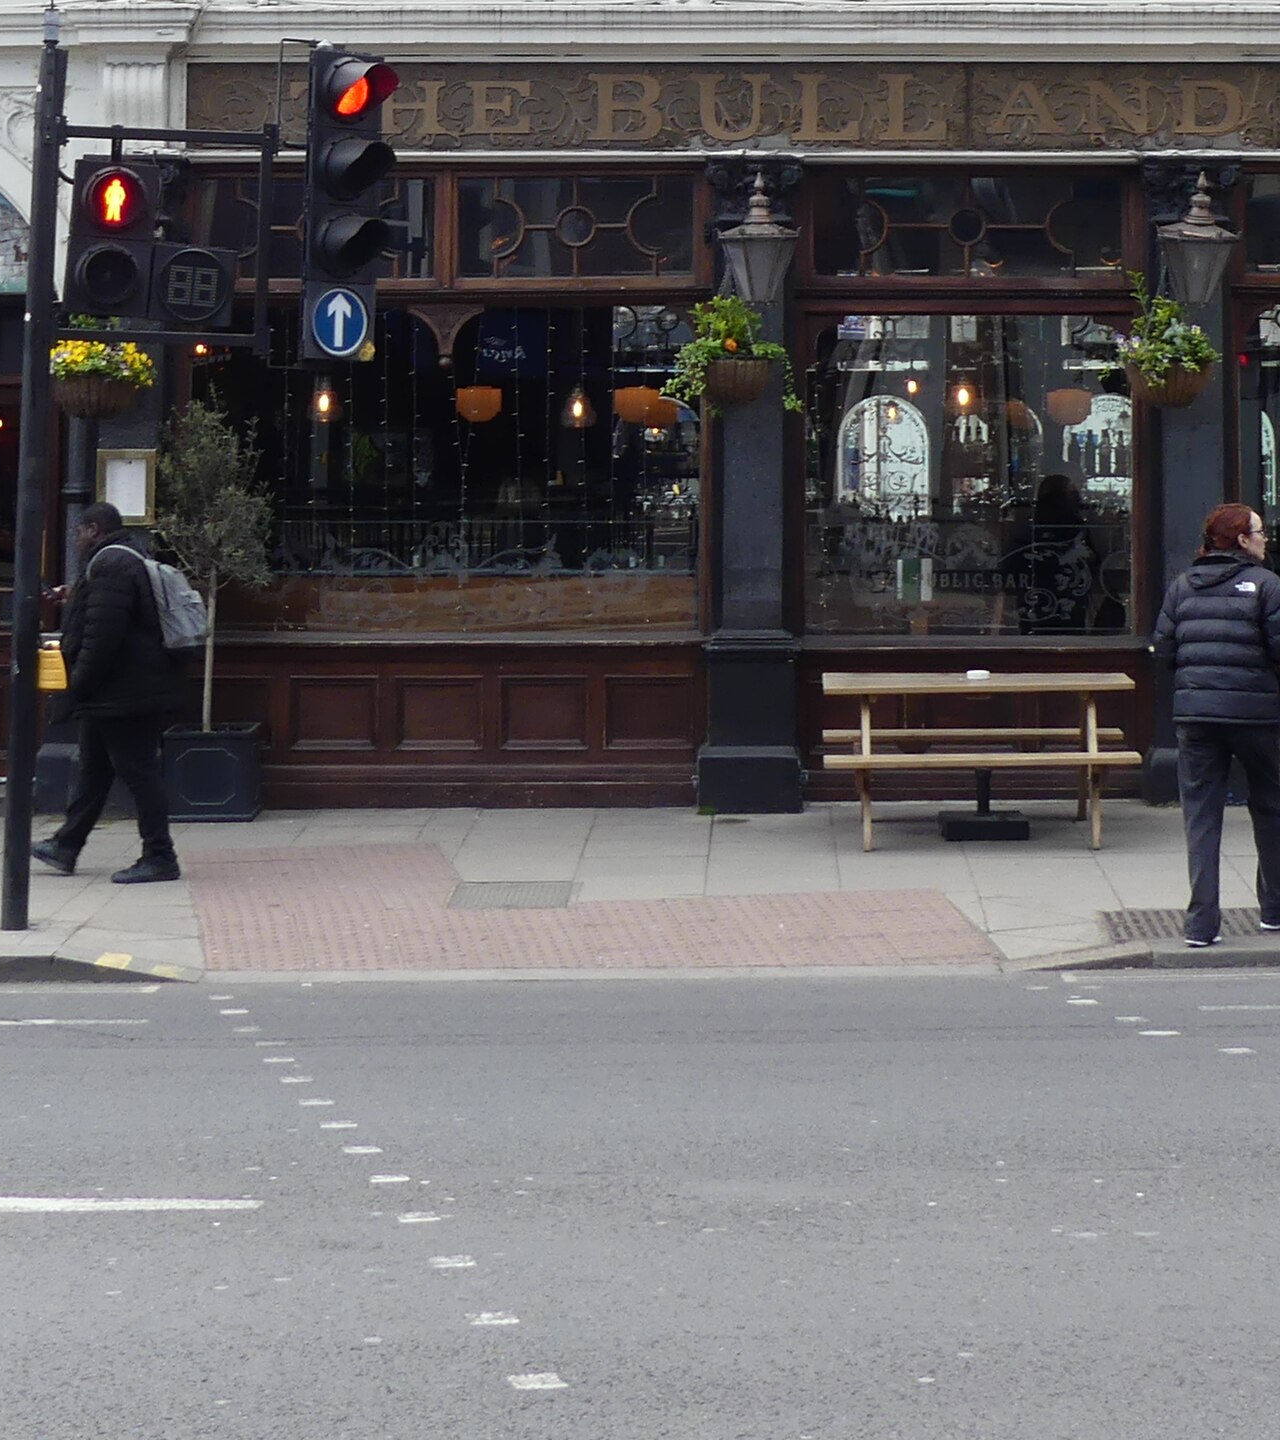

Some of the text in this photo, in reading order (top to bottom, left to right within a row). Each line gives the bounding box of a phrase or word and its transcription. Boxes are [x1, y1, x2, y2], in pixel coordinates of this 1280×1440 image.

[587, 73, 947, 142] BULL
[994, 77, 1245, 137] AND
[991, 572, 1030, 588] BAR
